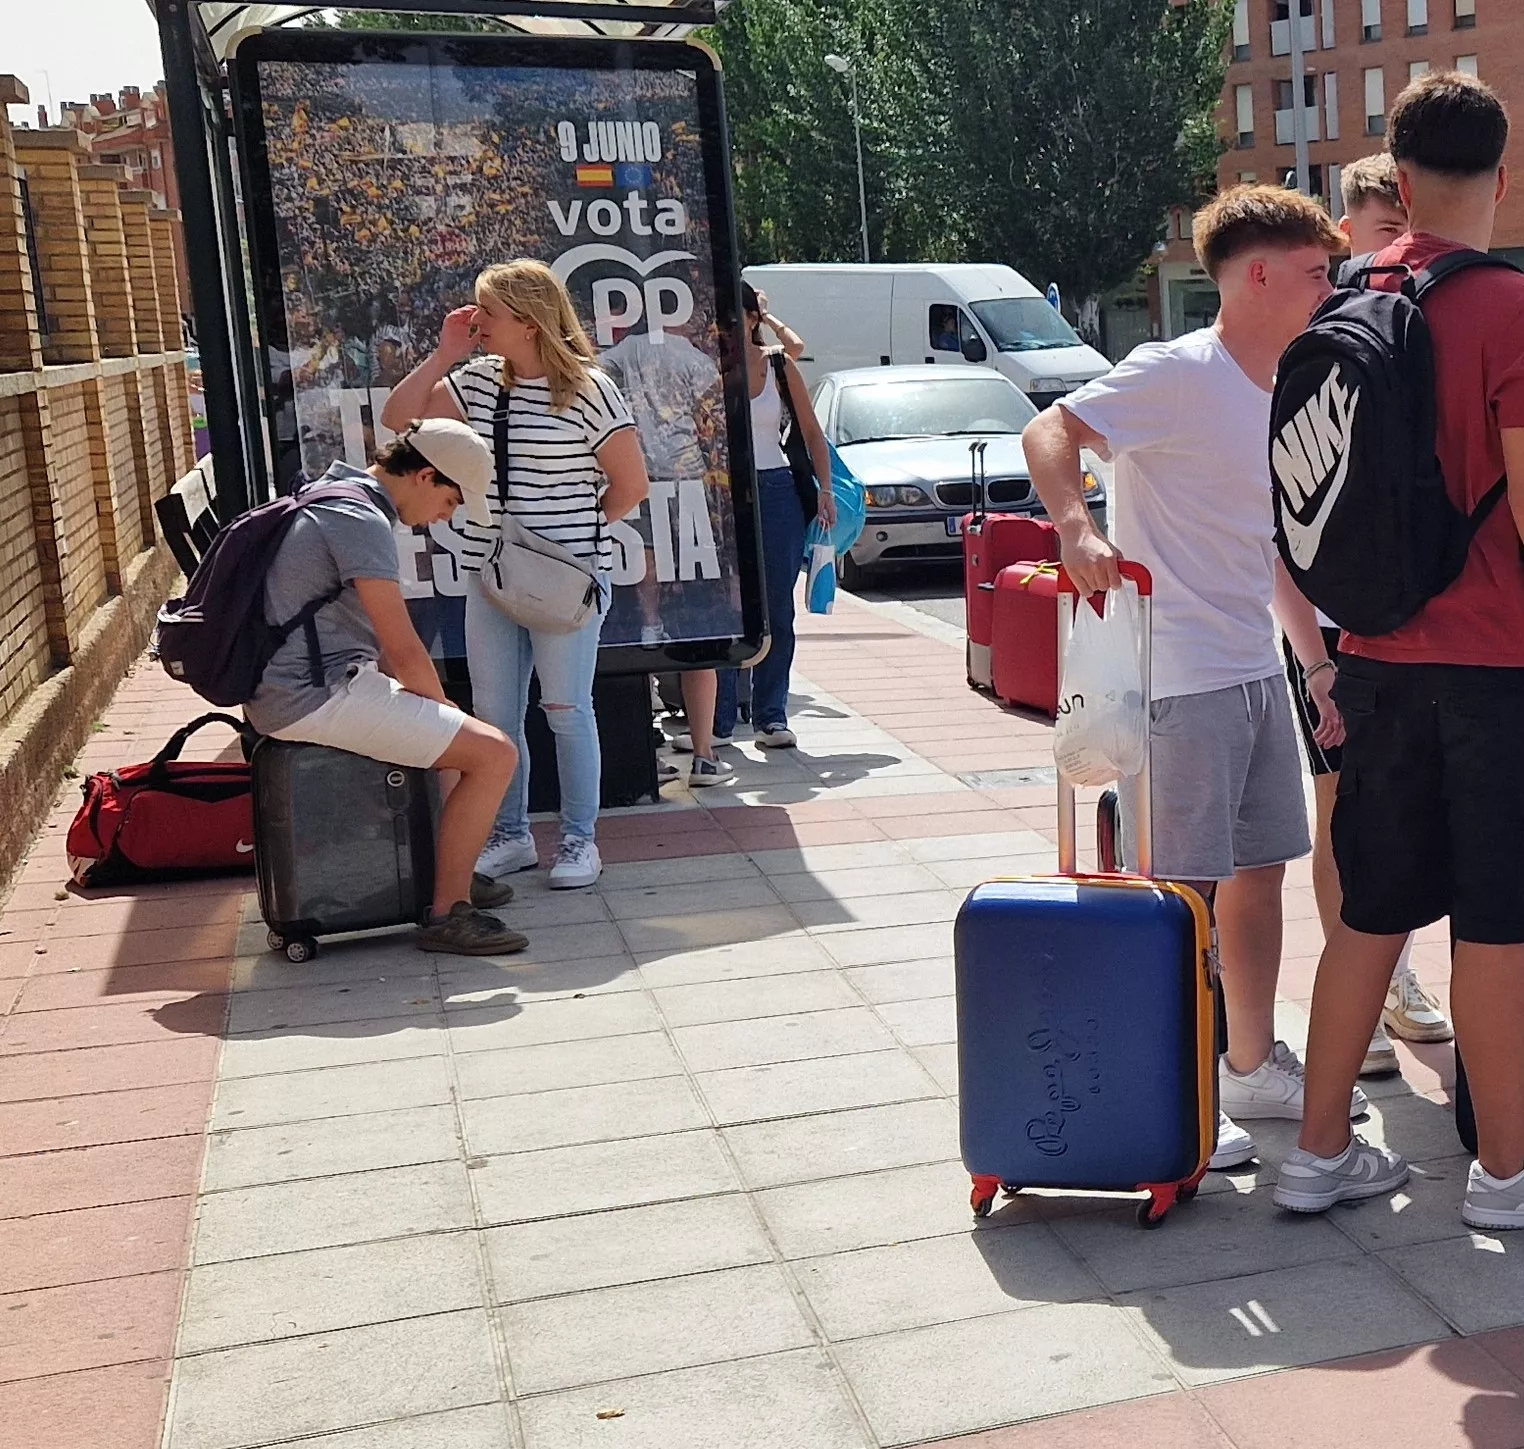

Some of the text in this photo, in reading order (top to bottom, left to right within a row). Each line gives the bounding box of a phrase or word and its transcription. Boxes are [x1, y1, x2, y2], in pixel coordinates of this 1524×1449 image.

[557, 120, 662, 163] 9 JUNIO
[546, 189, 686, 237] vota
[1272, 361, 1350, 515] NIKE
